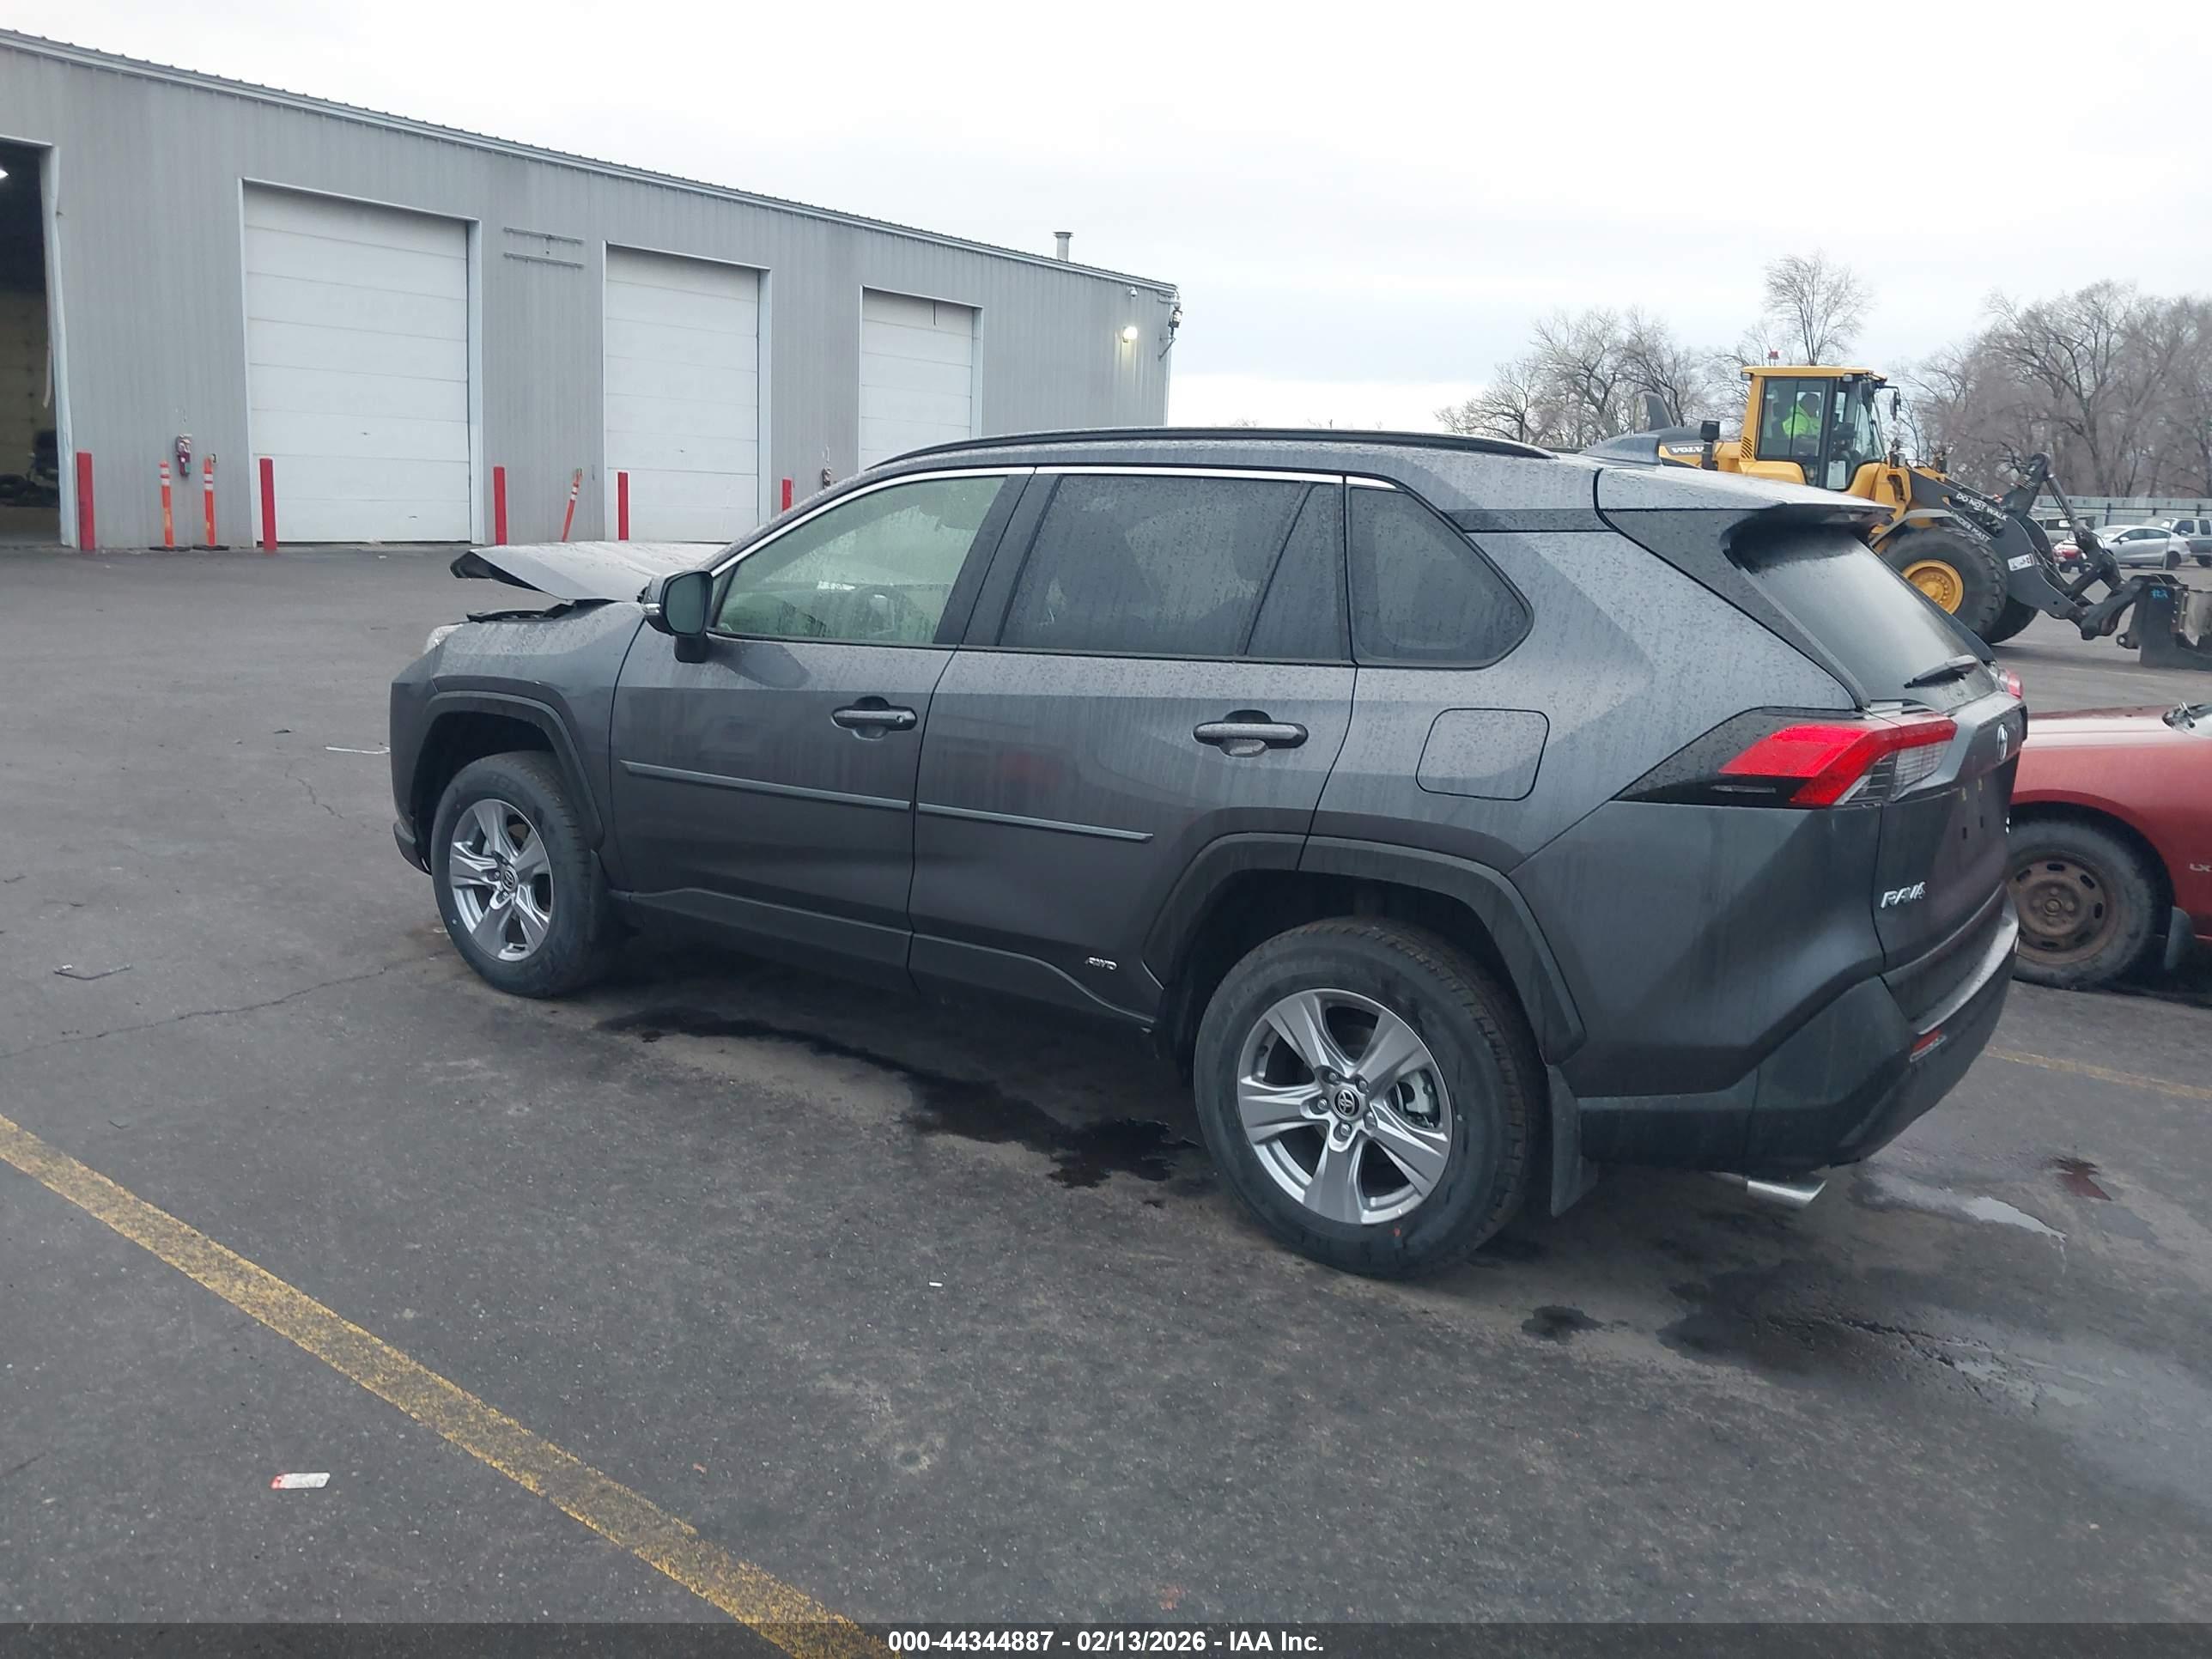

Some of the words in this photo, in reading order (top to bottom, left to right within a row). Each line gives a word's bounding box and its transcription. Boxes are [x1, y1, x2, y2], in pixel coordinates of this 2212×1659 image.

[1956, 493, 1969, 502] DO
[1968, 499, 1986, 510] NOT
[1986, 507, 2008, 522] WALK
